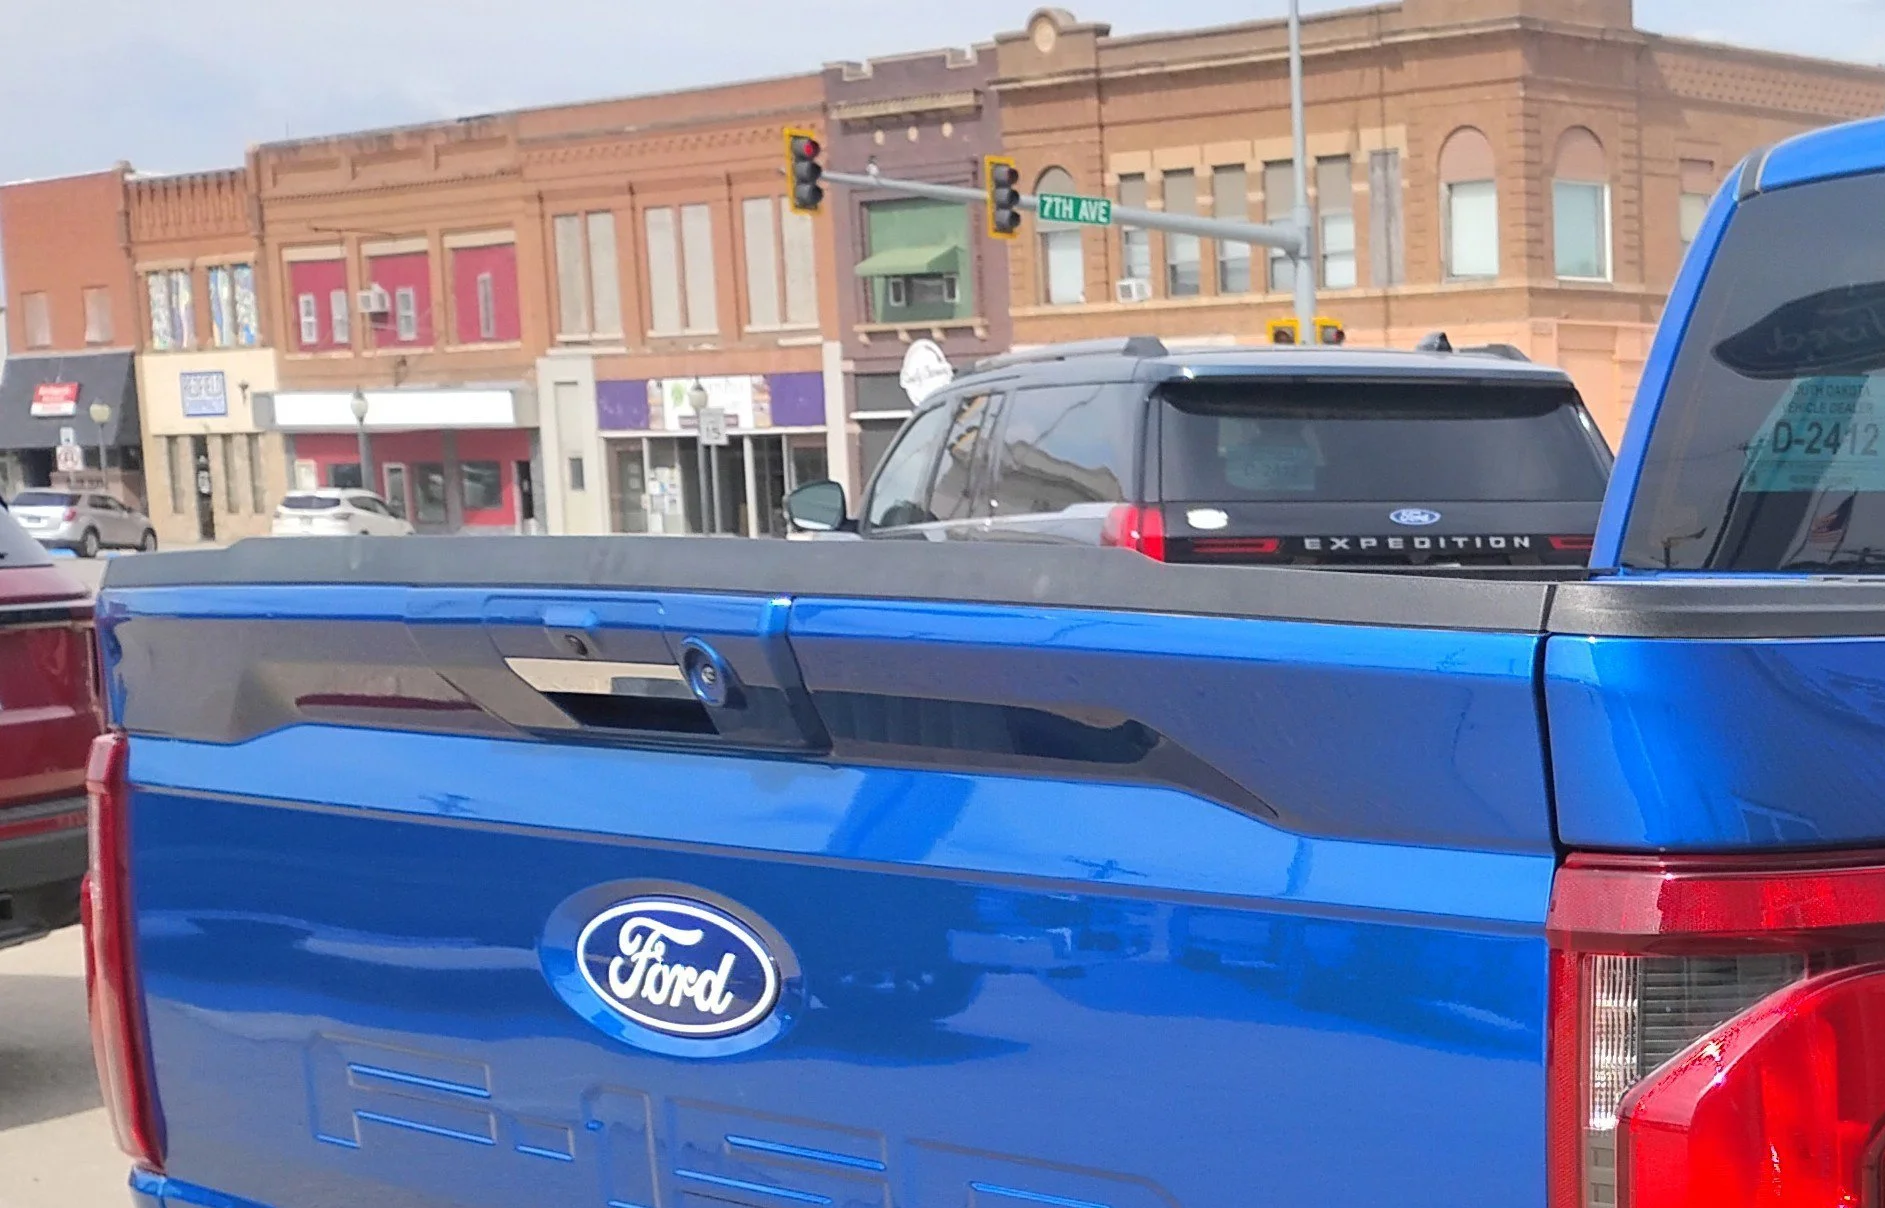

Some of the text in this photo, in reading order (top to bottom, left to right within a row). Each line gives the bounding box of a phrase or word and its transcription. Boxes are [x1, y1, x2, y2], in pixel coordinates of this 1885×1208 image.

[1042, 196, 1107, 223] 7TH AVE
[1772, 418, 1880, 456] D-2412
[1304, 536, 1530, 550] EXPEDITION
[609, 916, 735, 1015] Ford
